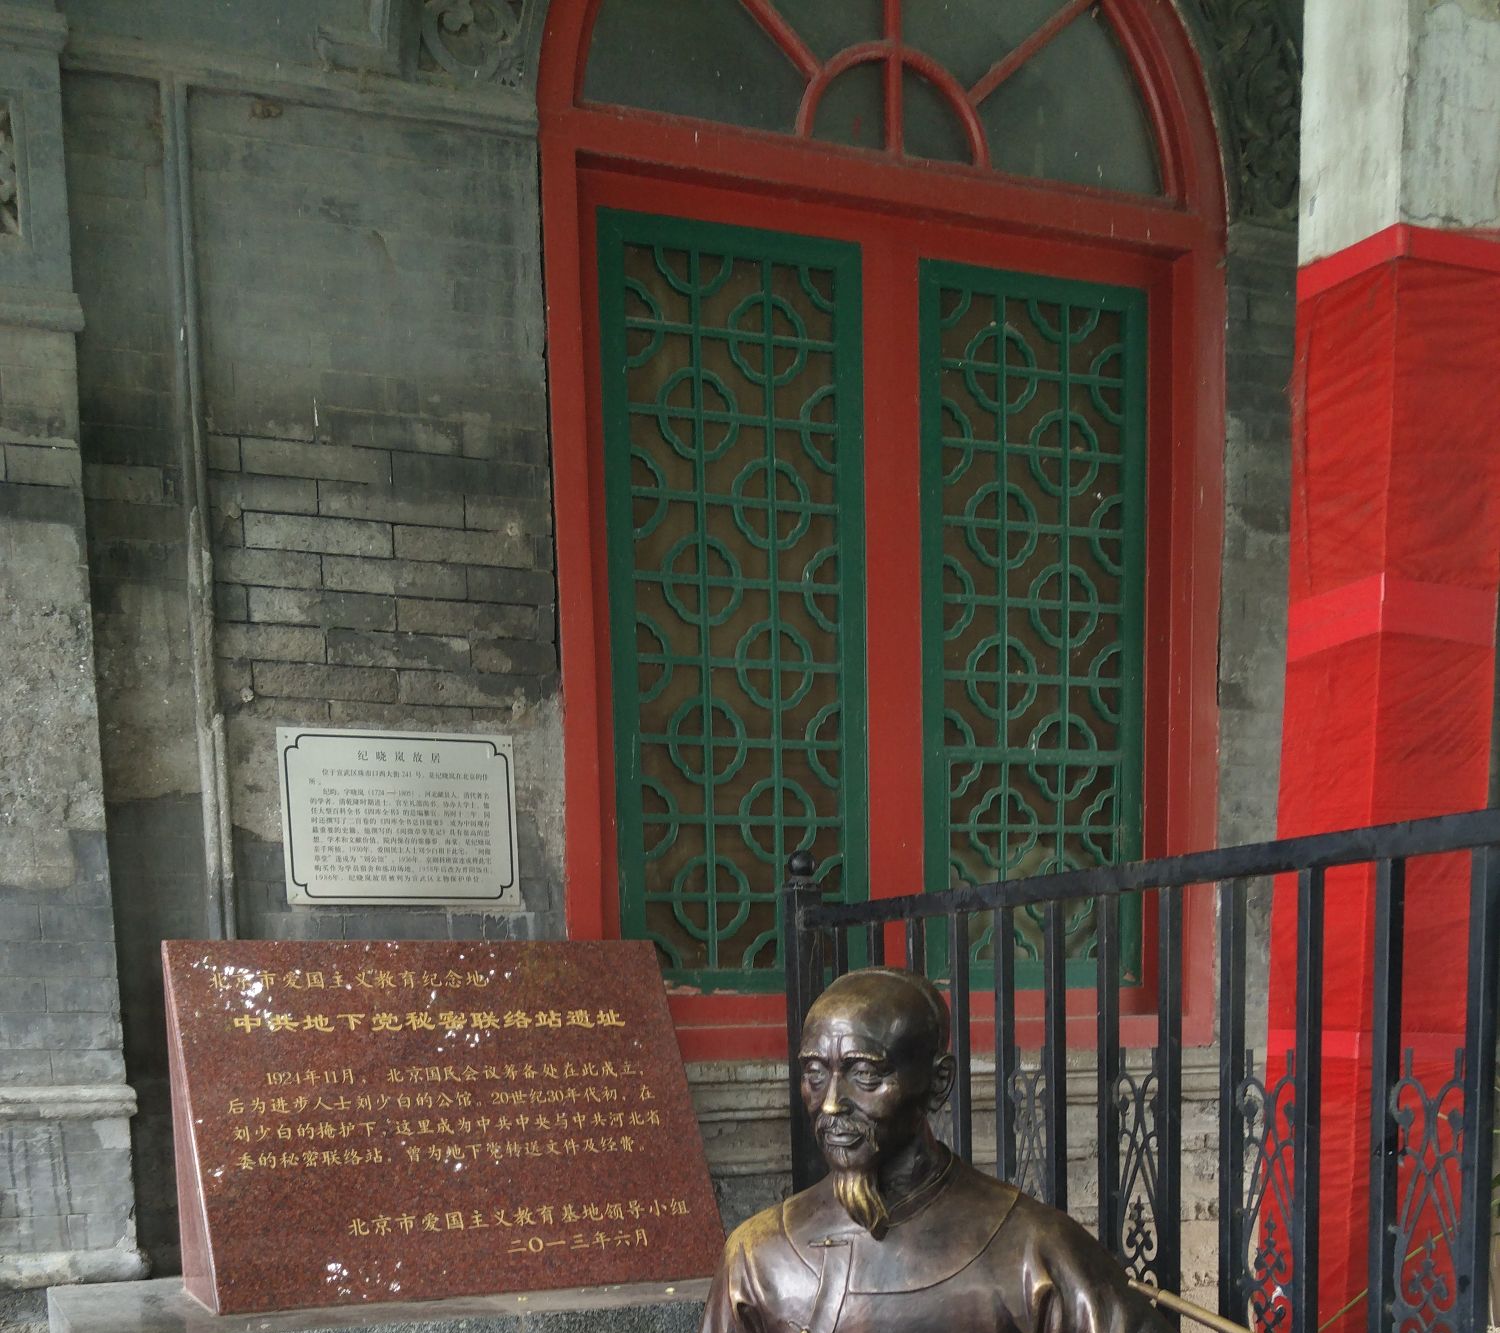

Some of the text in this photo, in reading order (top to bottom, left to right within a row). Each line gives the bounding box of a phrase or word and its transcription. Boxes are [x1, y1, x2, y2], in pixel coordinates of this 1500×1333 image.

[357, 750, 440, 763] 纪晓岚故居
[209, 969, 489, 990] 北京市爱国主义教育纪念地
[233, 1009, 626, 1034] 中共地下党秘密联络站遗址
[348, 1198, 690, 1237] 北京市爱国主义教育基地领导小组
